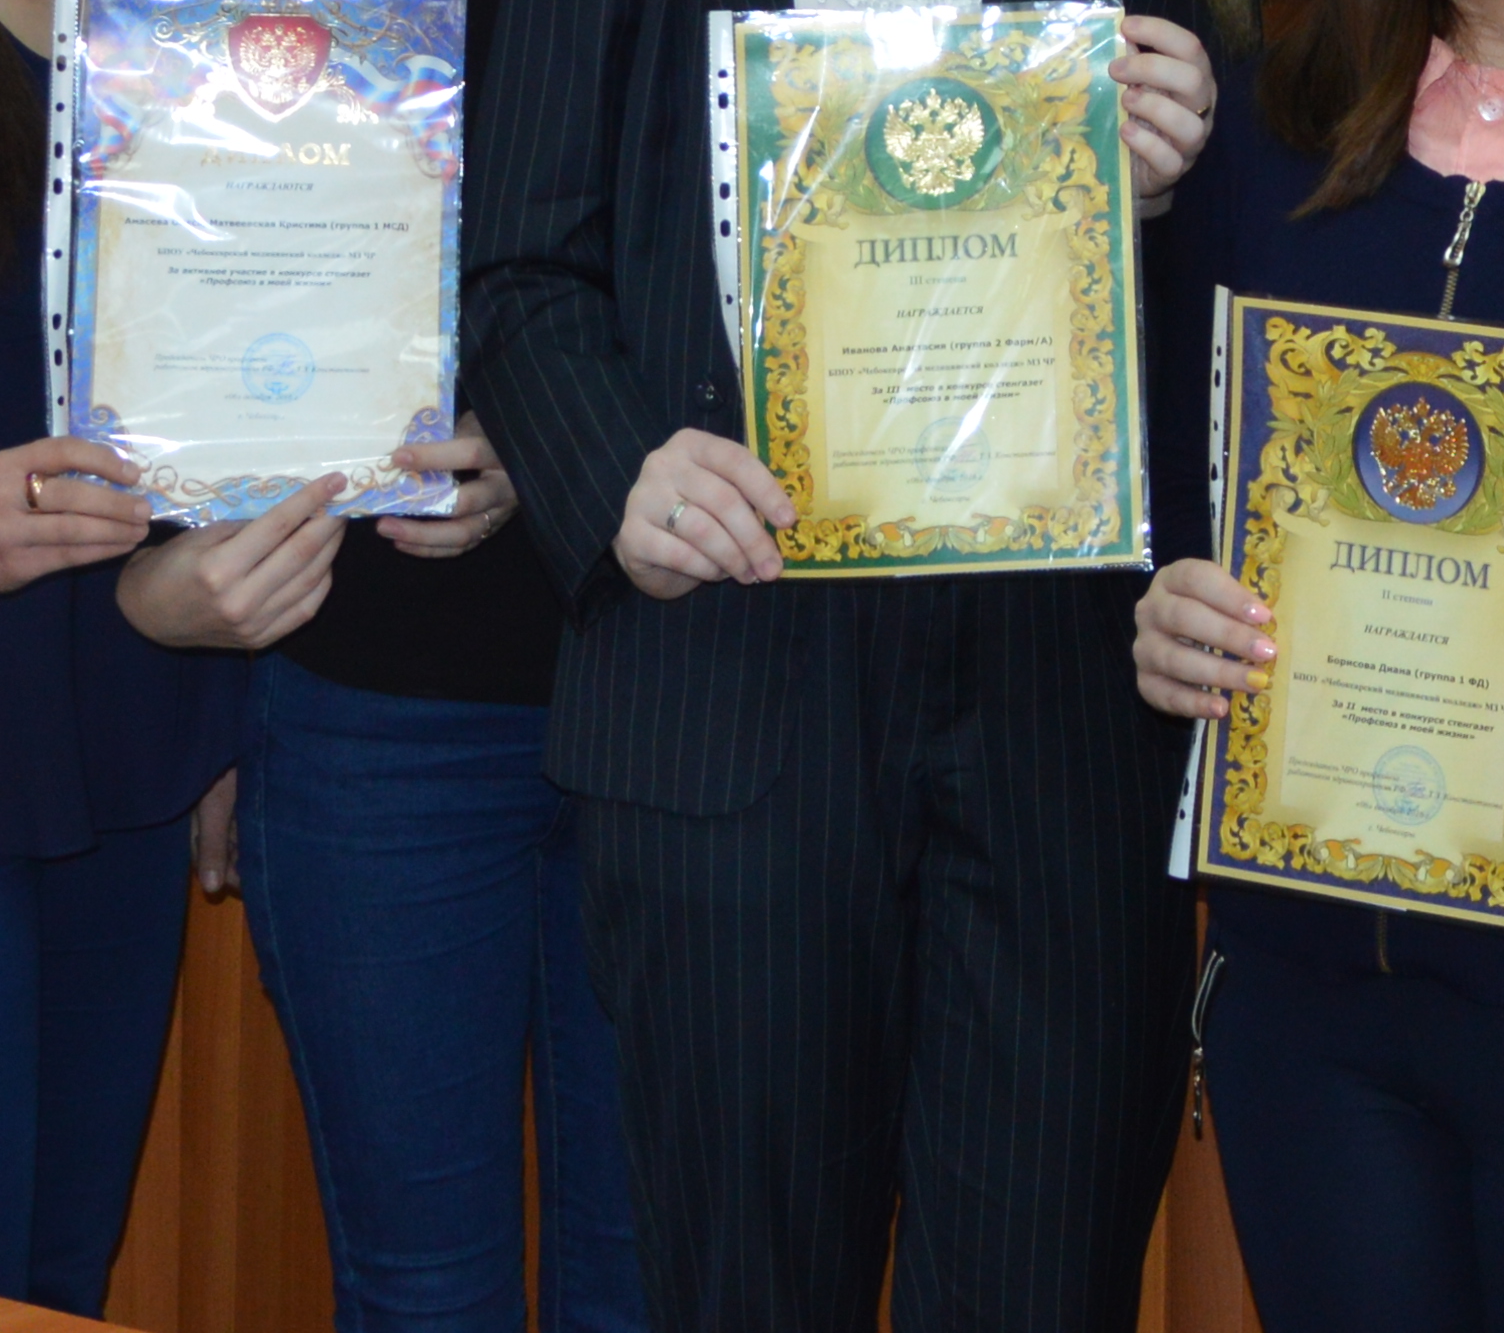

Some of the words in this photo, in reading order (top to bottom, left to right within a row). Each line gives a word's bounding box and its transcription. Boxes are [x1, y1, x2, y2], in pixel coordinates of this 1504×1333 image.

[854, 233, 1019, 270] ДИПЛОМ
[1330, 540, 1491, 590] ДИПЛОМ
[1363, 623, 1449, 646] НАГРАЖДАЕТСЯ
[1325, 654, 1377, 671] Борисова
[1377, 662, 1412, 677] Диана
[1413, 668, 1456, 684] (группа
[1466, 676, 1490, 690] ФД)
